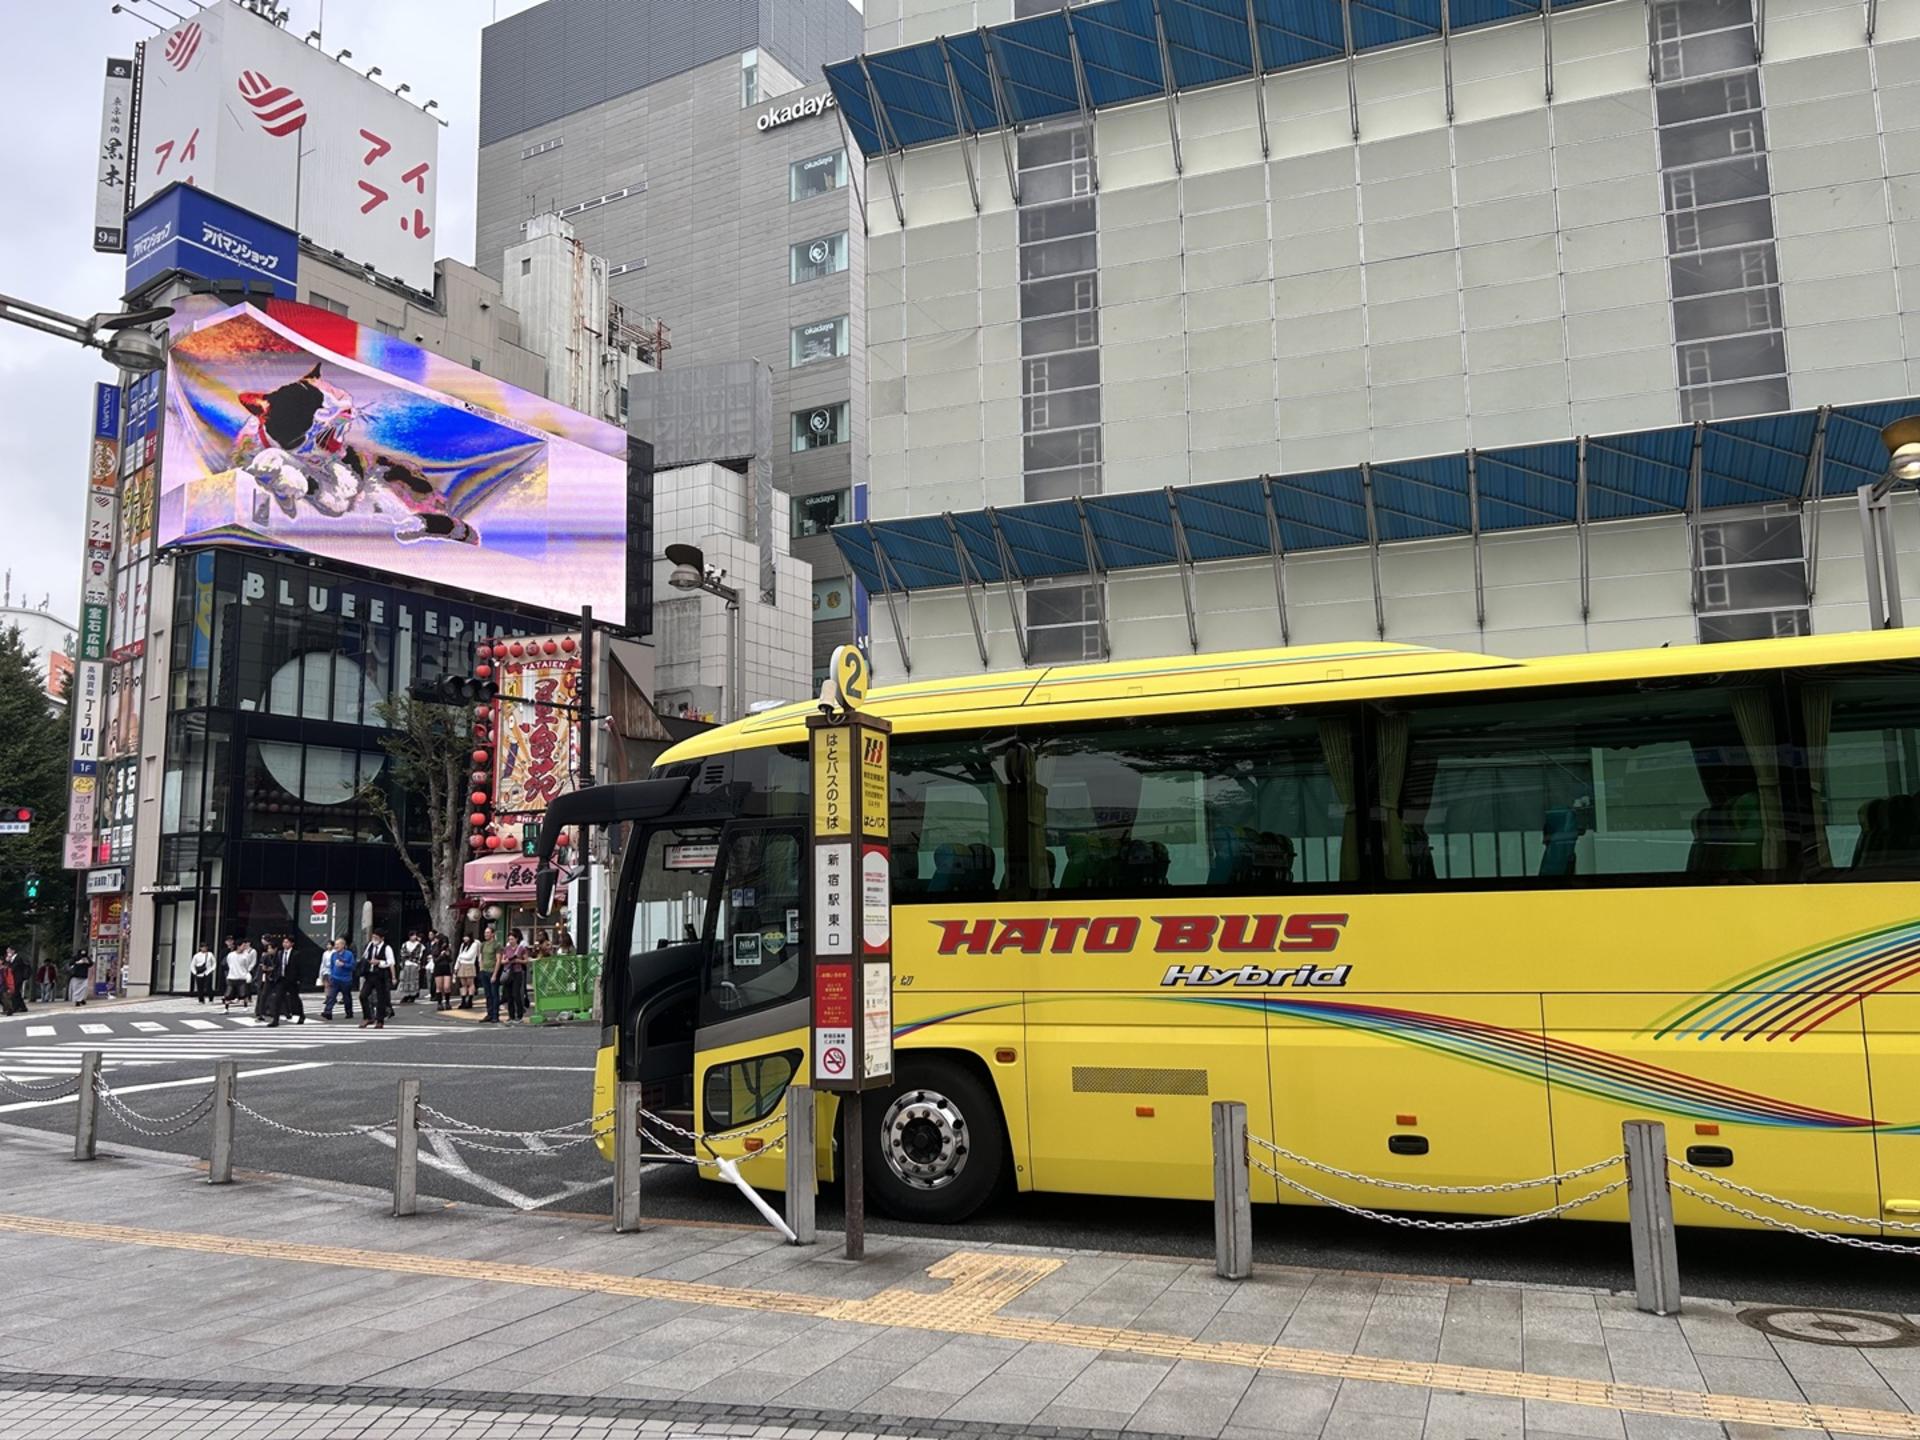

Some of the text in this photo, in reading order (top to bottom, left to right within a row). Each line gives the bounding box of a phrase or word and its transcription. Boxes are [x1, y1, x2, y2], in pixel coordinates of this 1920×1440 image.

[756, 91, 838, 131] okadaya
[803, 156, 833, 170] okadaya
[202, 227, 279, 269] アパマンショップ
[804, 322, 834, 335] okadaya
[86, 607, 103, 658] 宝石広場
[522, 661, 567, 670] YATAIEN
[845, 652, 862, 700] 2
[80, 764, 92, 773] 1F
[826, 733, 839, 829] はとバスのりば
[864, 816, 885, 829] はとバス
[505, 864, 539, 890] 屋台
[827, 853, 840, 946] 新宿駅東口
[928, 913, 1350, 955] HATO BUS
[1160, 963, 1353, 987] Hybrid
